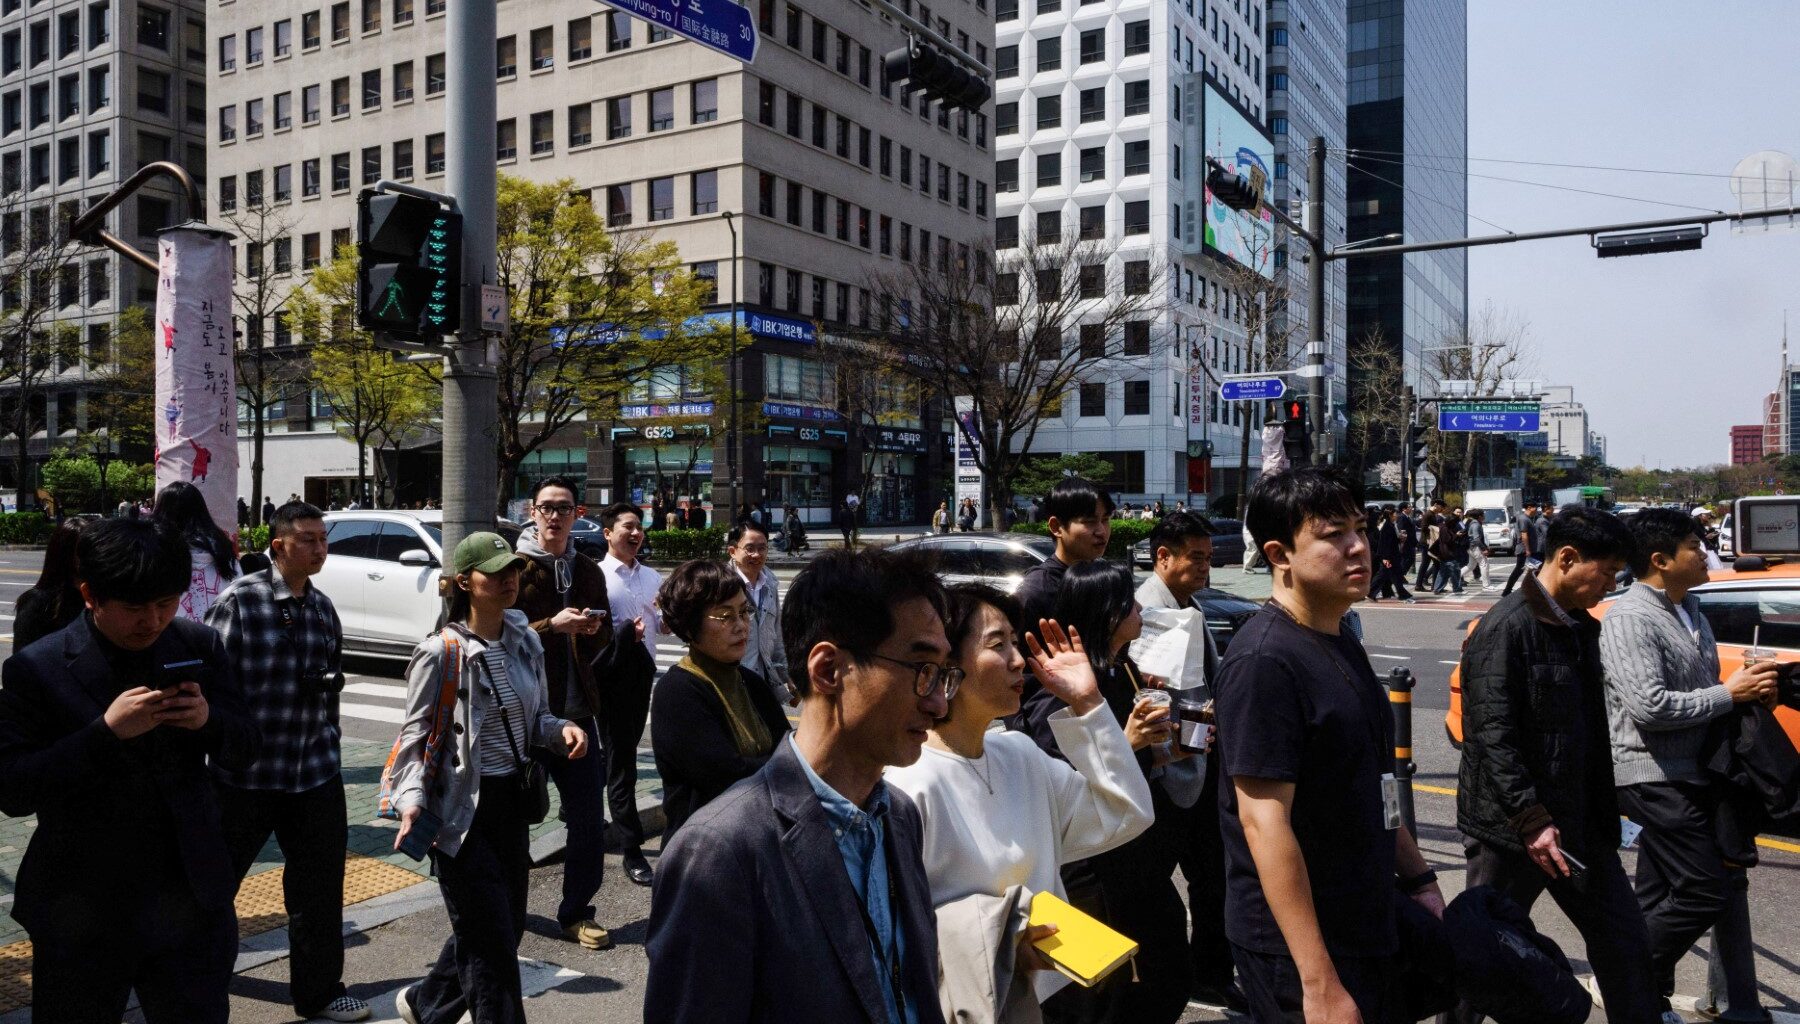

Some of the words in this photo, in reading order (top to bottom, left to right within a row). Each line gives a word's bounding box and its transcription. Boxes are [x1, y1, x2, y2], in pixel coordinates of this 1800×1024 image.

[681, 15, 730, 48] 国际金融路
[740, 24, 750, 42] 30
[202, 300, 215, 347] 지금도
[218, 326, 228, 355] 오고
[204, 362, 215, 394] 봄이
[219, 370, 230, 436] 있습니다
[632, 406, 648, 416] IBK
[770, 405, 780, 414] IBK
[645, 426, 674, 439] GS25
[800, 428, 819, 440] GS25
